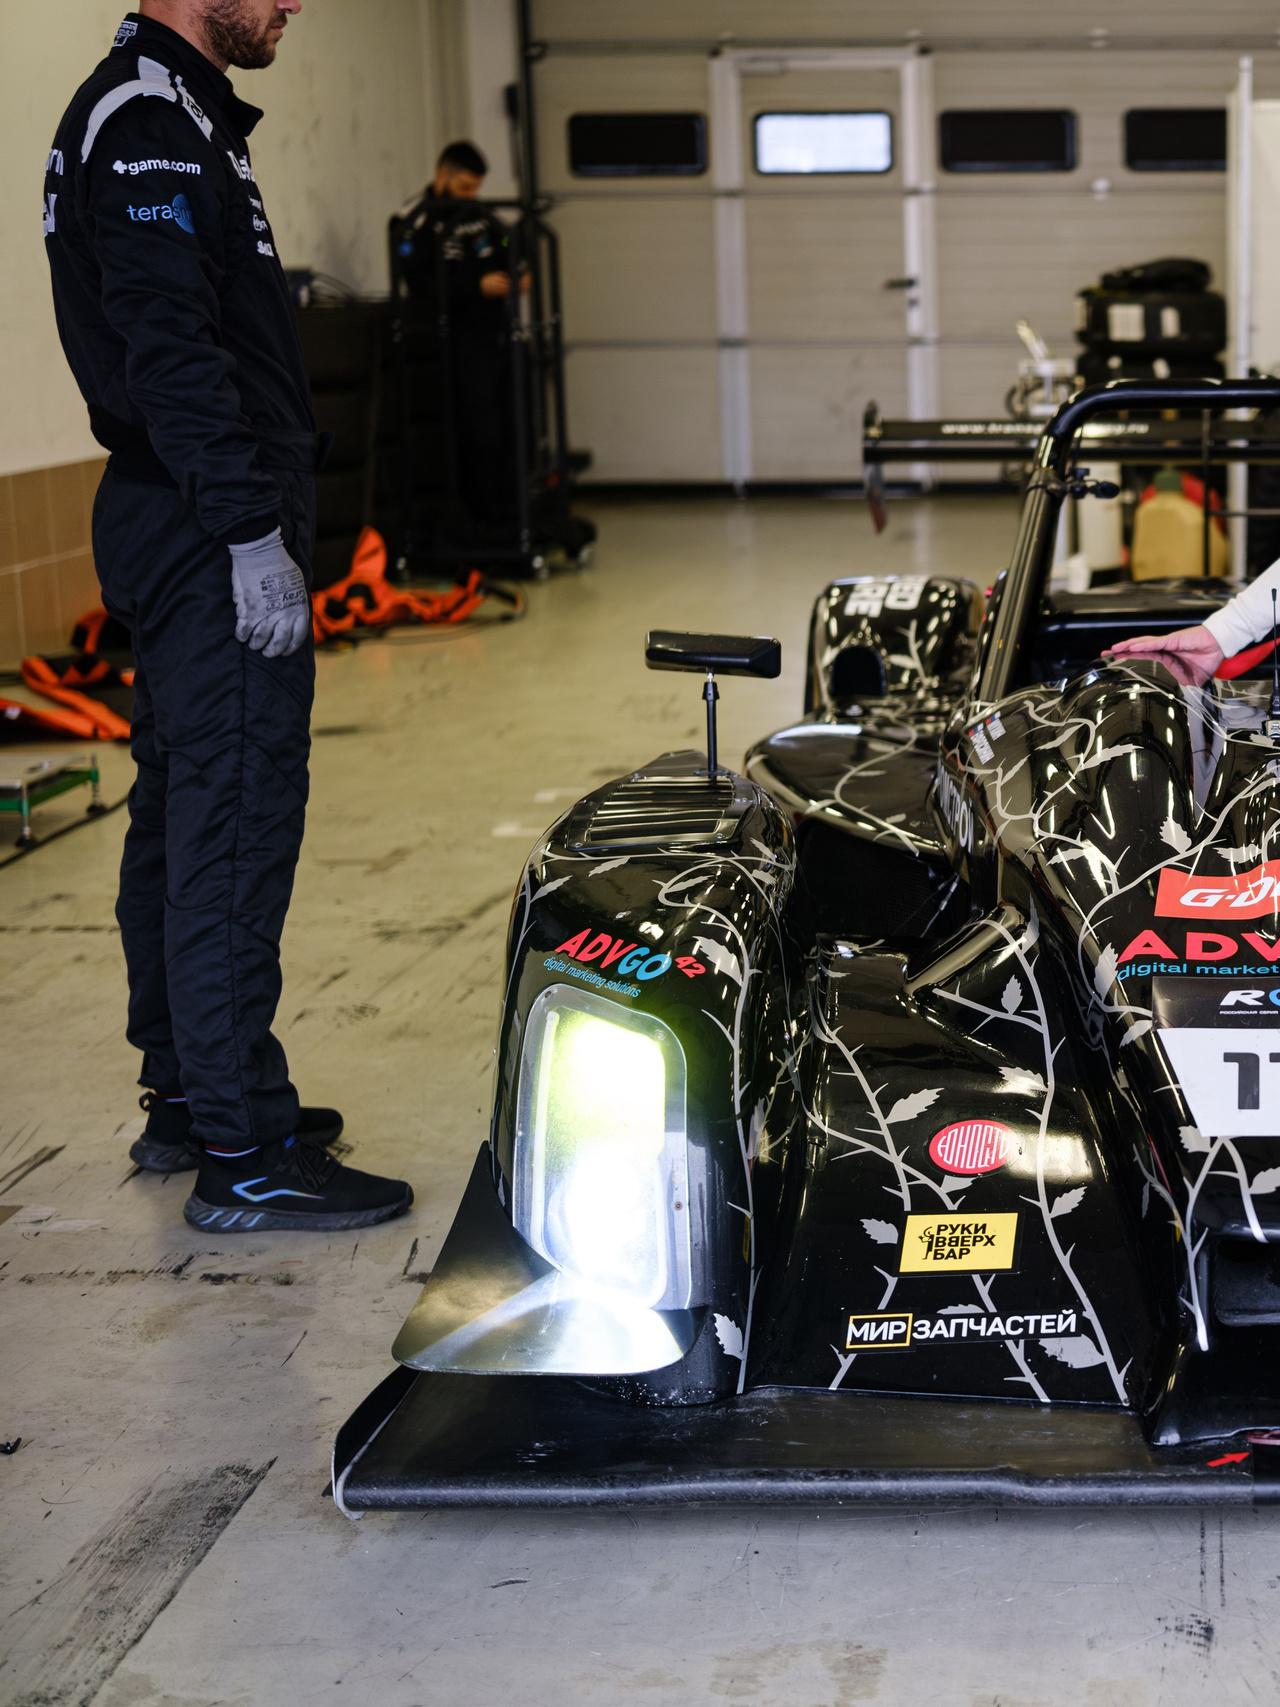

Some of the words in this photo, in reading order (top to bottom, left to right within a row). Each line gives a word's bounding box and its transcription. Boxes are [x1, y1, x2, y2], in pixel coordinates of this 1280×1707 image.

[542, 956, 569, 973] digital
[566, 965, 607, 988] marketing
[604, 979, 642, 998] solutions
[1116, 960, 1188, 981] digital
[937, 1124, 1012, 1170] ЮНОСТЬ
[935, 1223, 988, 1236] РУКИ
[932, 1247, 971, 1261] БАР
[848, 1321, 907, 1342] МИР
[911, 1308, 1077, 1340] ЗАПЧАСТЕЙ
